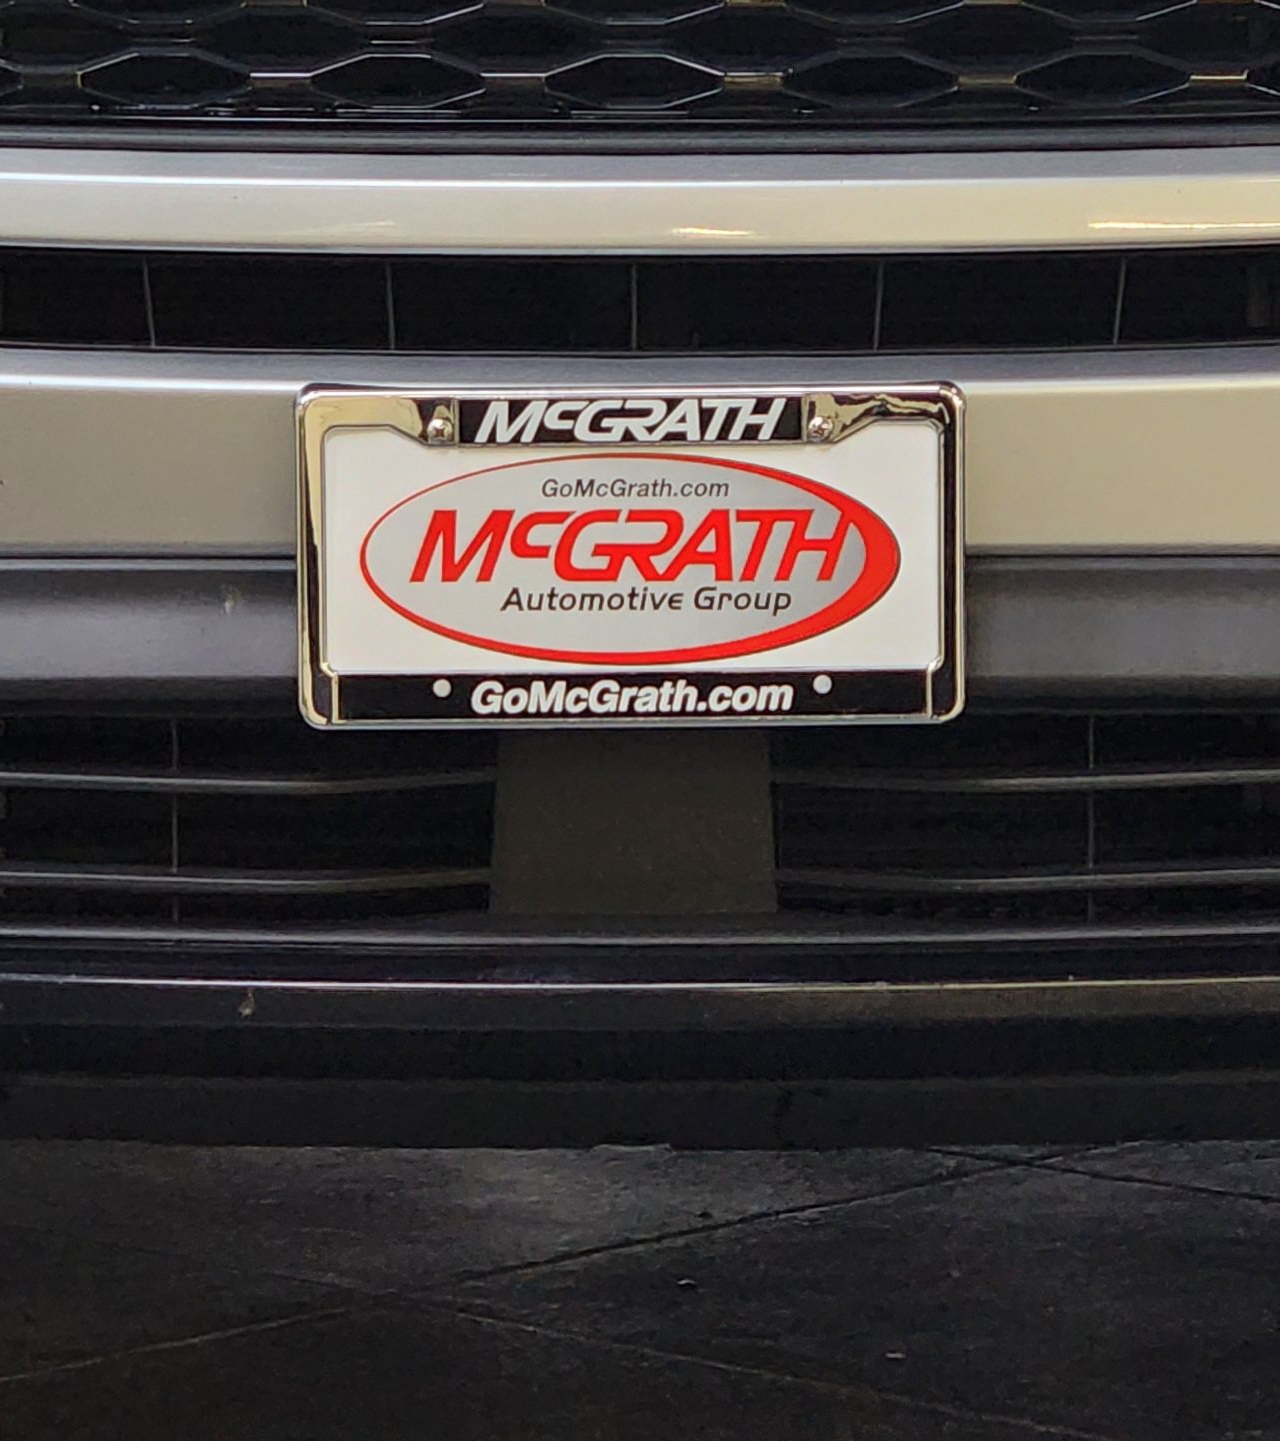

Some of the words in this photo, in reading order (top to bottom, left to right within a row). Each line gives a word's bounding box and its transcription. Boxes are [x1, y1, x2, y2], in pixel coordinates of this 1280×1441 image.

[541, 477, 730, 499] GoMcGrath.com
[500, 585, 684, 613] Automotive
[693, 586, 792, 617] Group
[470, 679, 794, 715] GoMcGrath.com
